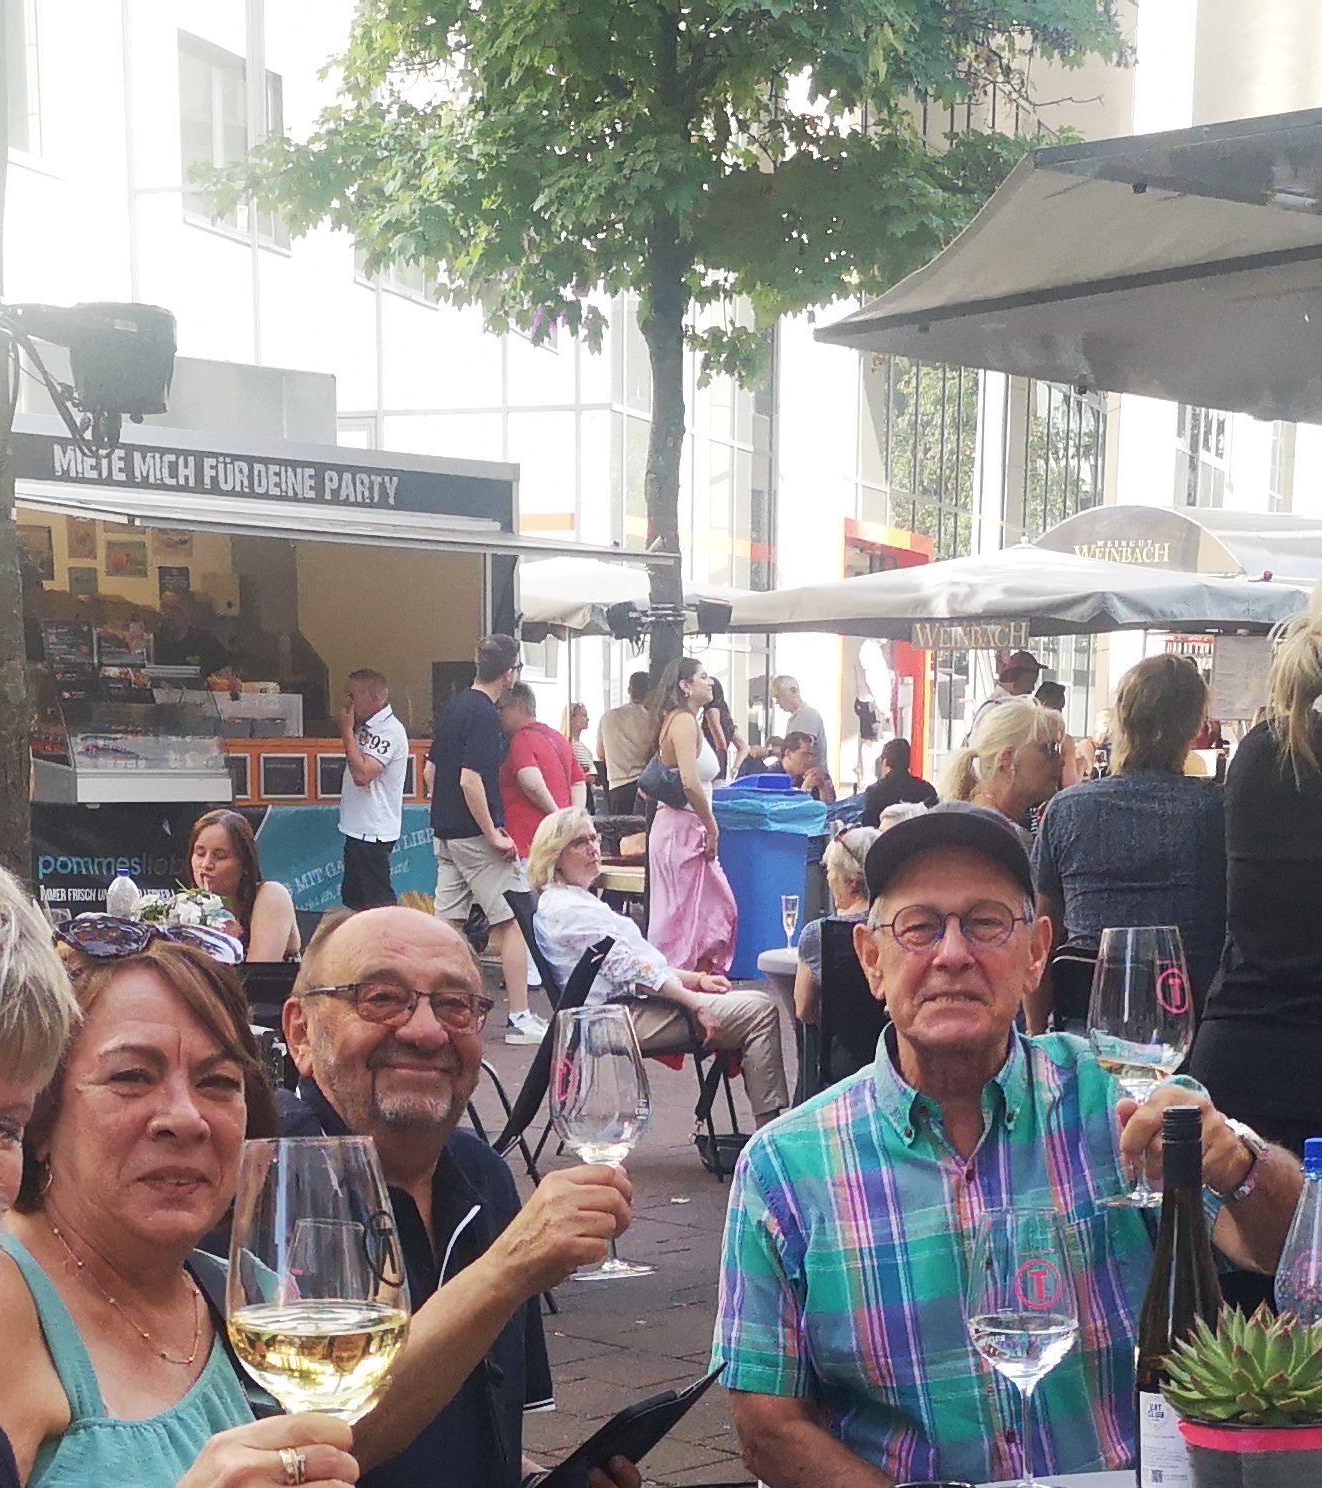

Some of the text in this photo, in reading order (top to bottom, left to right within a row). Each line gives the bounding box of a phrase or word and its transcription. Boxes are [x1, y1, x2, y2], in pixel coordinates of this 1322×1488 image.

[53, 443, 399, 506] MIETE MICH FÜR DEINE PARTY
[1073, 542, 1171, 563] WEINBACH
[914, 620, 1027, 649] WEINBACH
[294, 867, 324, 894] MIT
